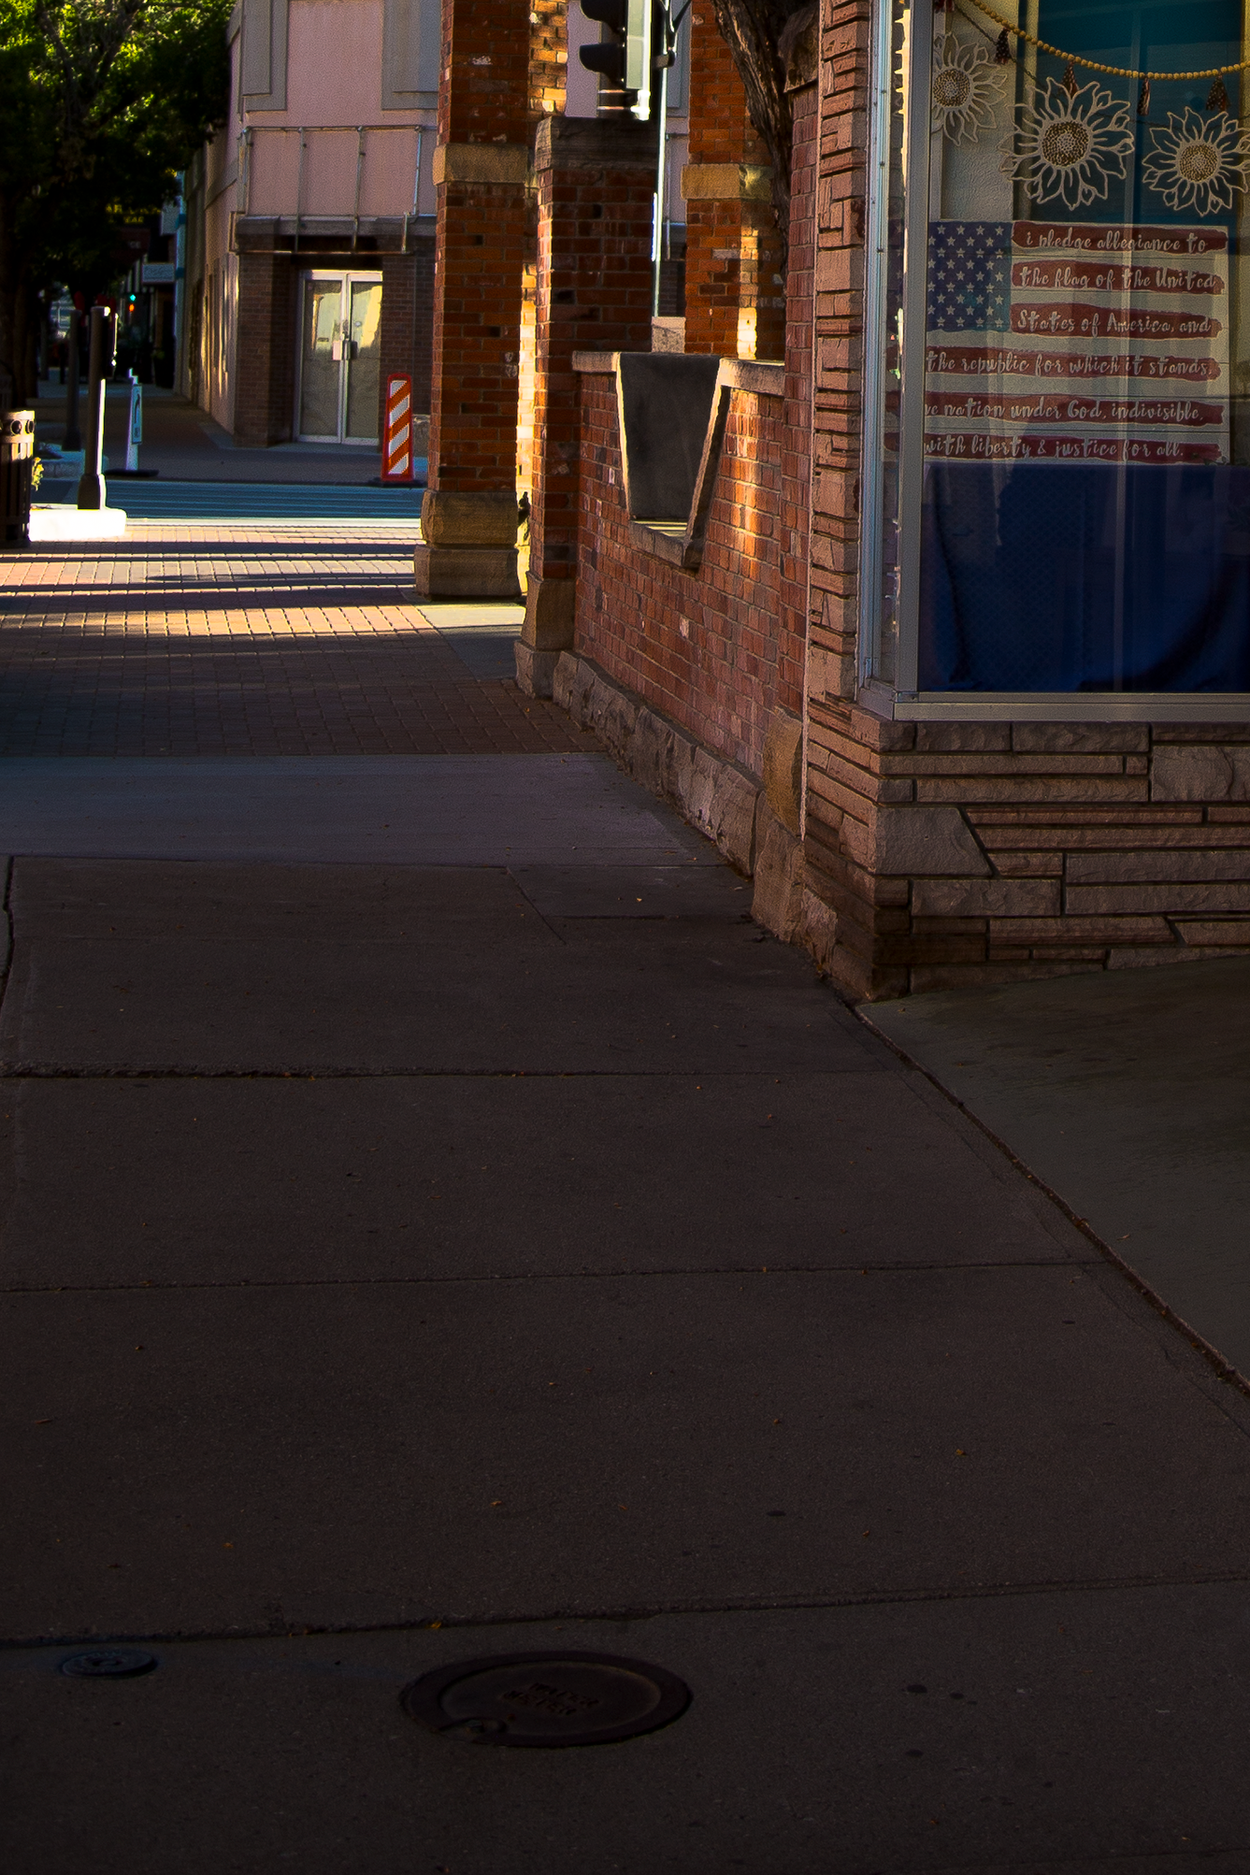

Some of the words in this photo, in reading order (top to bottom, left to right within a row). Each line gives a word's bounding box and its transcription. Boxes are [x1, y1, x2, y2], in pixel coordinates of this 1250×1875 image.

[1039, 227, 1092, 251] pledge
[1097, 230, 1181, 252] allegiance
[1186, 232, 1209, 253] to
[1019, 267, 1049, 286] the
[1054, 267, 1091, 289] flag
[1095, 268, 1115, 290] of
[1121, 270, 1151, 290] the
[1155, 268, 1217, 291] United
[1018, 309, 1076, 333] States
[1081, 312, 1100, 338] of
[1106, 312, 1174, 333] America,
[1179, 317, 1211, 333] and
[926, 350, 956, 372] the
[961, 351, 1030, 375] republic
[1034, 353, 1064, 376] for
[1069, 356, 1120, 374] which
[1125, 355, 1144, 375] it
[944, 397, 1005, 418] nation
[1010, 396, 1061, 419] under
[1067, 399, 1107, 419] God,
[1111, 401, 1203, 422] indivisible,
[924, 435, 966, 456] with
[970, 434, 1031, 458] liberty
[1037, 438, 1046, 455] &
[1052, 438, 1117, 458] justice
[1122, 438, 1151, 462] for
[1156, 442, 1184, 456] all.
